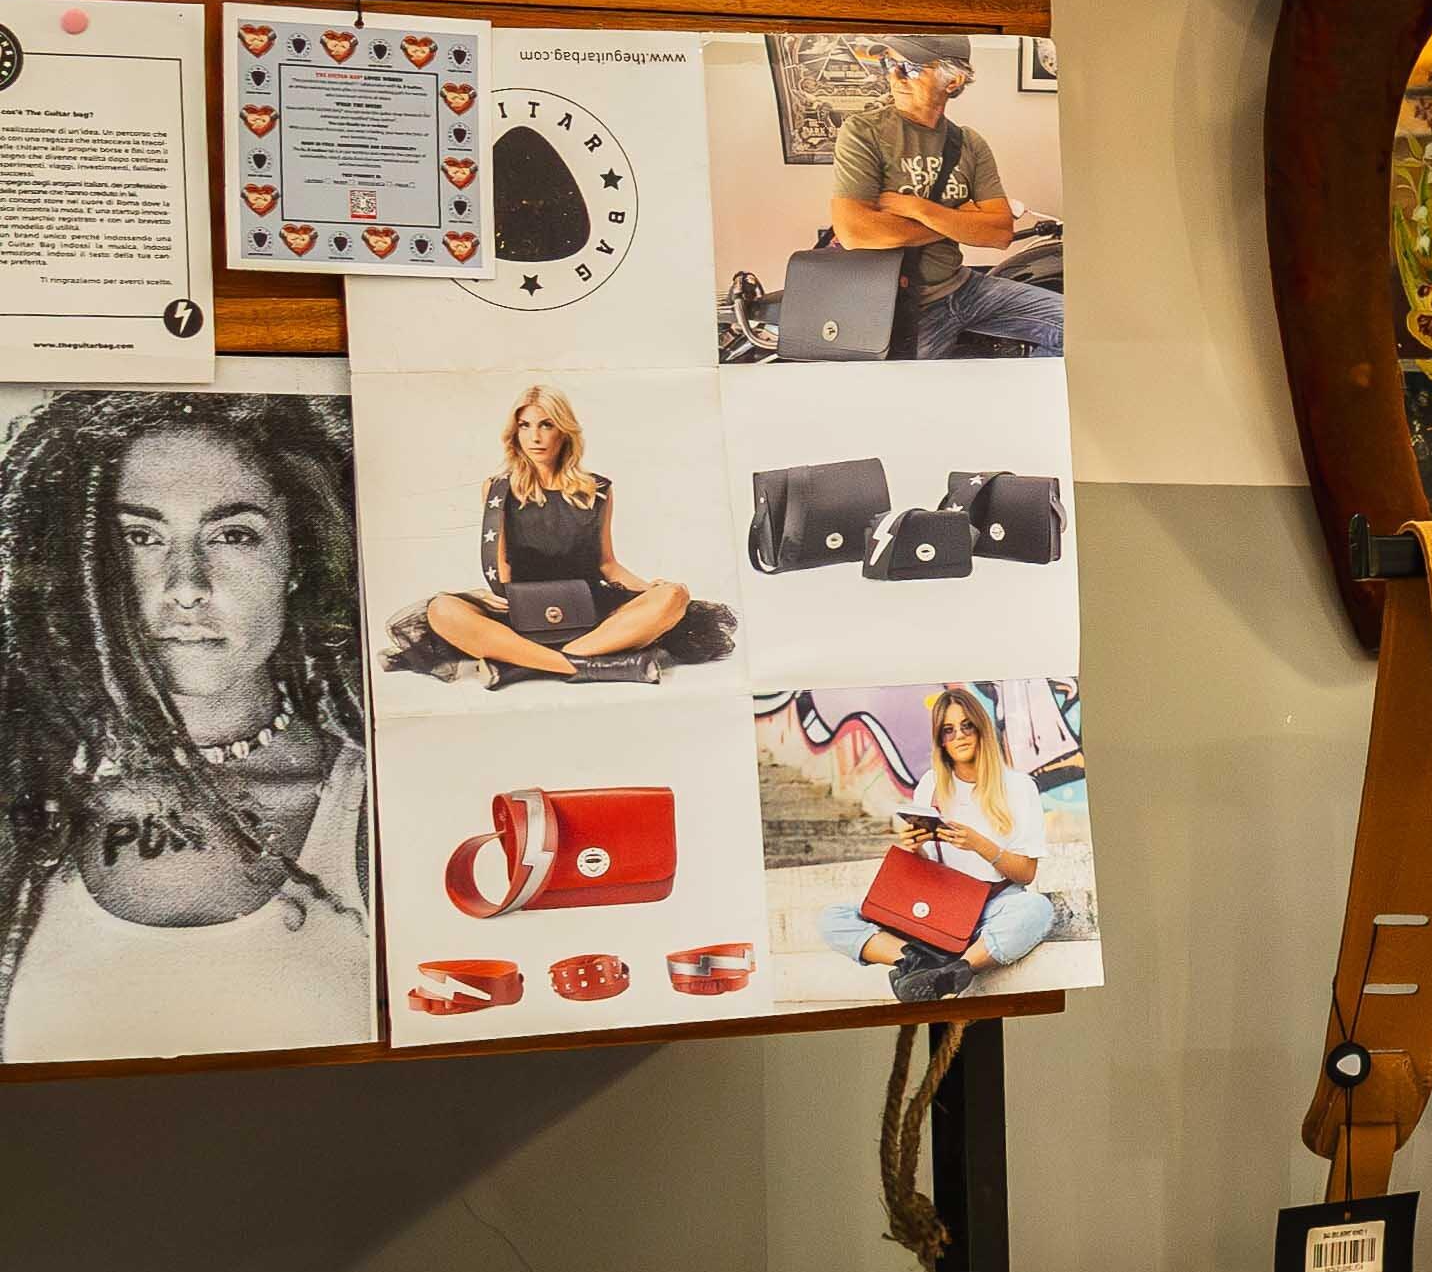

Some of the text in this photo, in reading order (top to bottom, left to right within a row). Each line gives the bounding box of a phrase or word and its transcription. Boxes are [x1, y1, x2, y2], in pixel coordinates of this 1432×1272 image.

[519, 49, 687, 64] www.theguitarbag.com
[44, 109, 70, 117] Guitar
[73, 110, 94, 119] bag?
[100, 145, 122, 153] borse
[108, 155, 129, 163] dopo
[497, 101, 626, 282] ITAR BAG
[40, 241, 56, 249] Bag
[103, 278, 118, 286] per
[33, 341, 134, 350] www.theguitarbag.com
